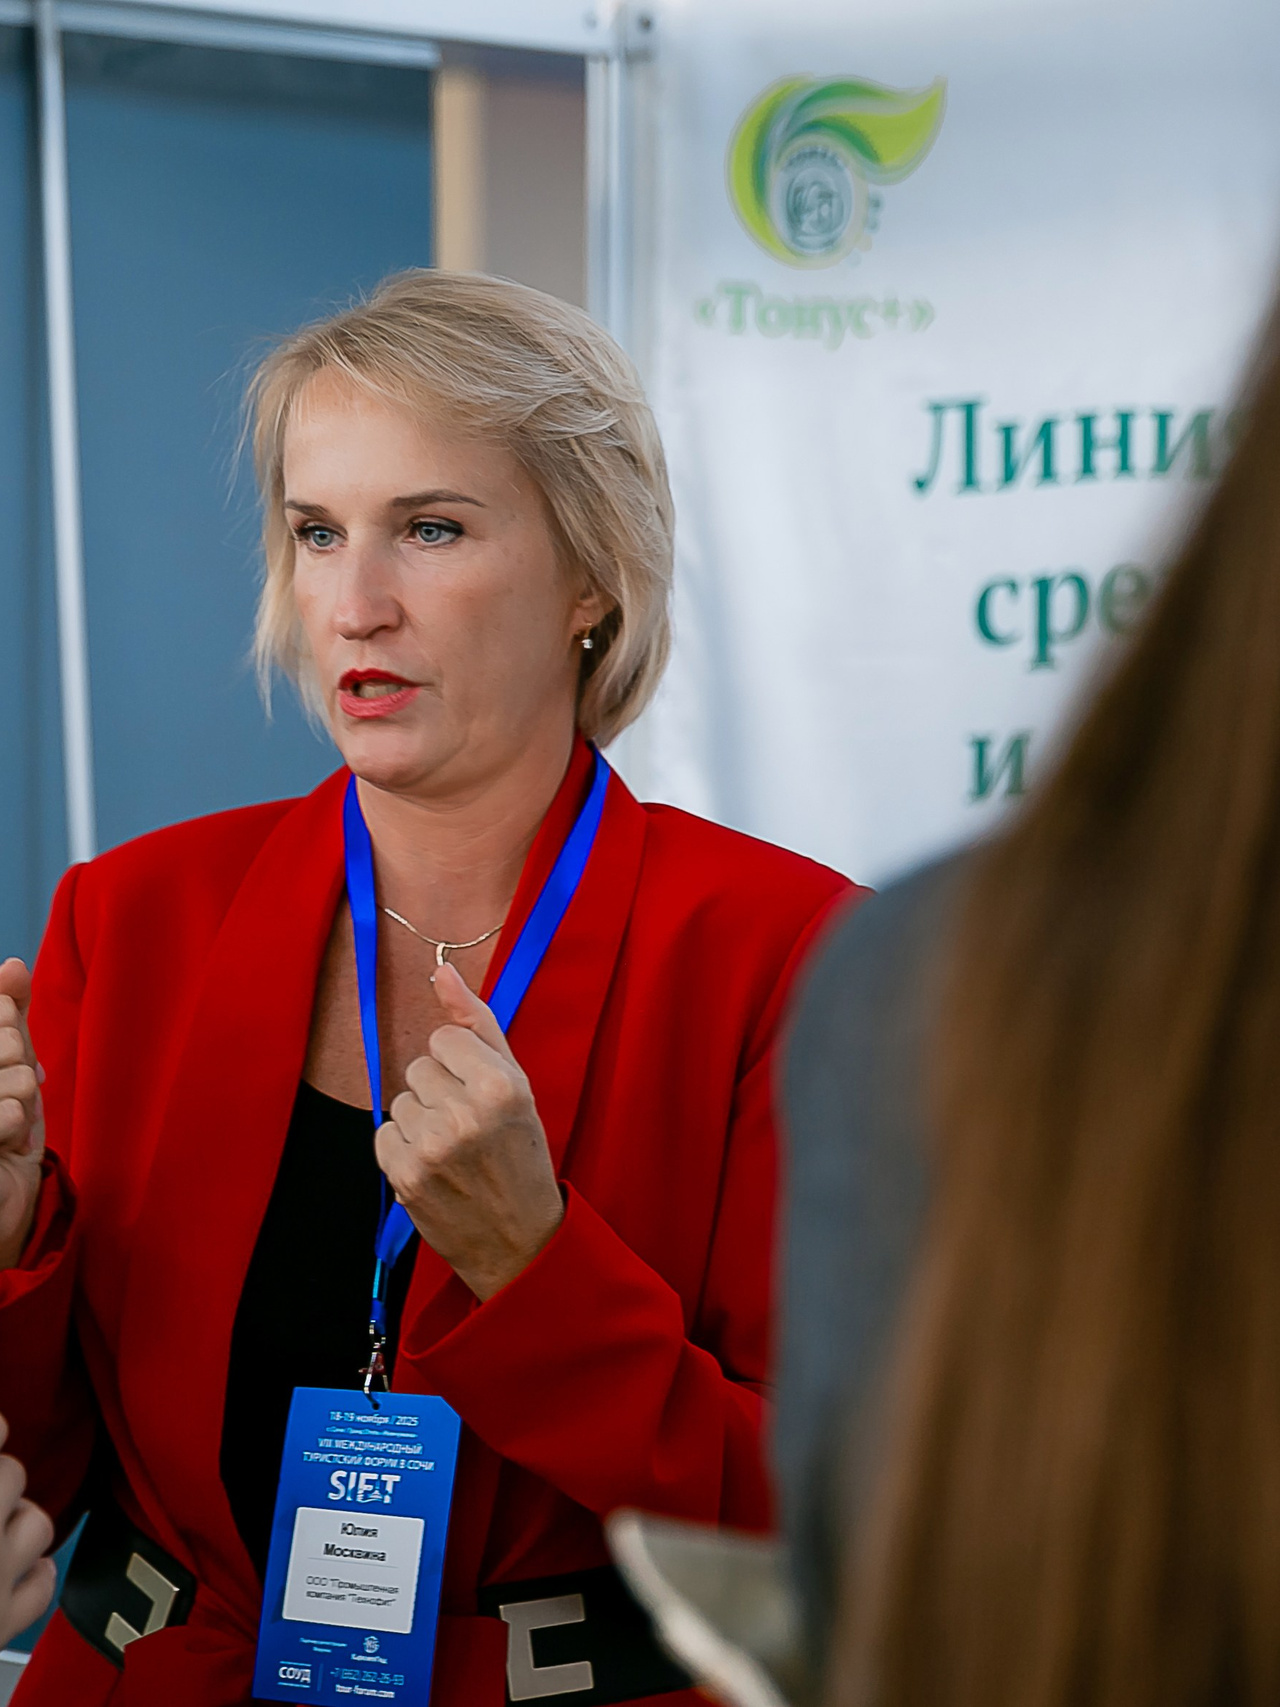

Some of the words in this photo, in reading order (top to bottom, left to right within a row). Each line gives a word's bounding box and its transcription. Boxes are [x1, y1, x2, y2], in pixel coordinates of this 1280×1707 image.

[974, 564, 1152, 670] сре
[329, 1411, 356, 1422] 18-19
[356, 1413, 390, 1426] ноября
[395, 1415, 420, 1426] 2025
[334, 1438, 423, 1455] МЕЖДУНАРОДНЫЙ
[303, 1451, 363, 1466] ТУРИСТСКИЙ
[364, 1456, 399, 1468] ФОРУМ
[406, 1459, 435, 1471] СОЧИ
[340, 1522, 379, 1538] Юлия
[323, 1543, 387, 1562] Москвина
[306, 1575, 328, 1586] ООО
[306, 1591, 346, 1601] компания
[278, 1666, 312, 1684] СОУД
